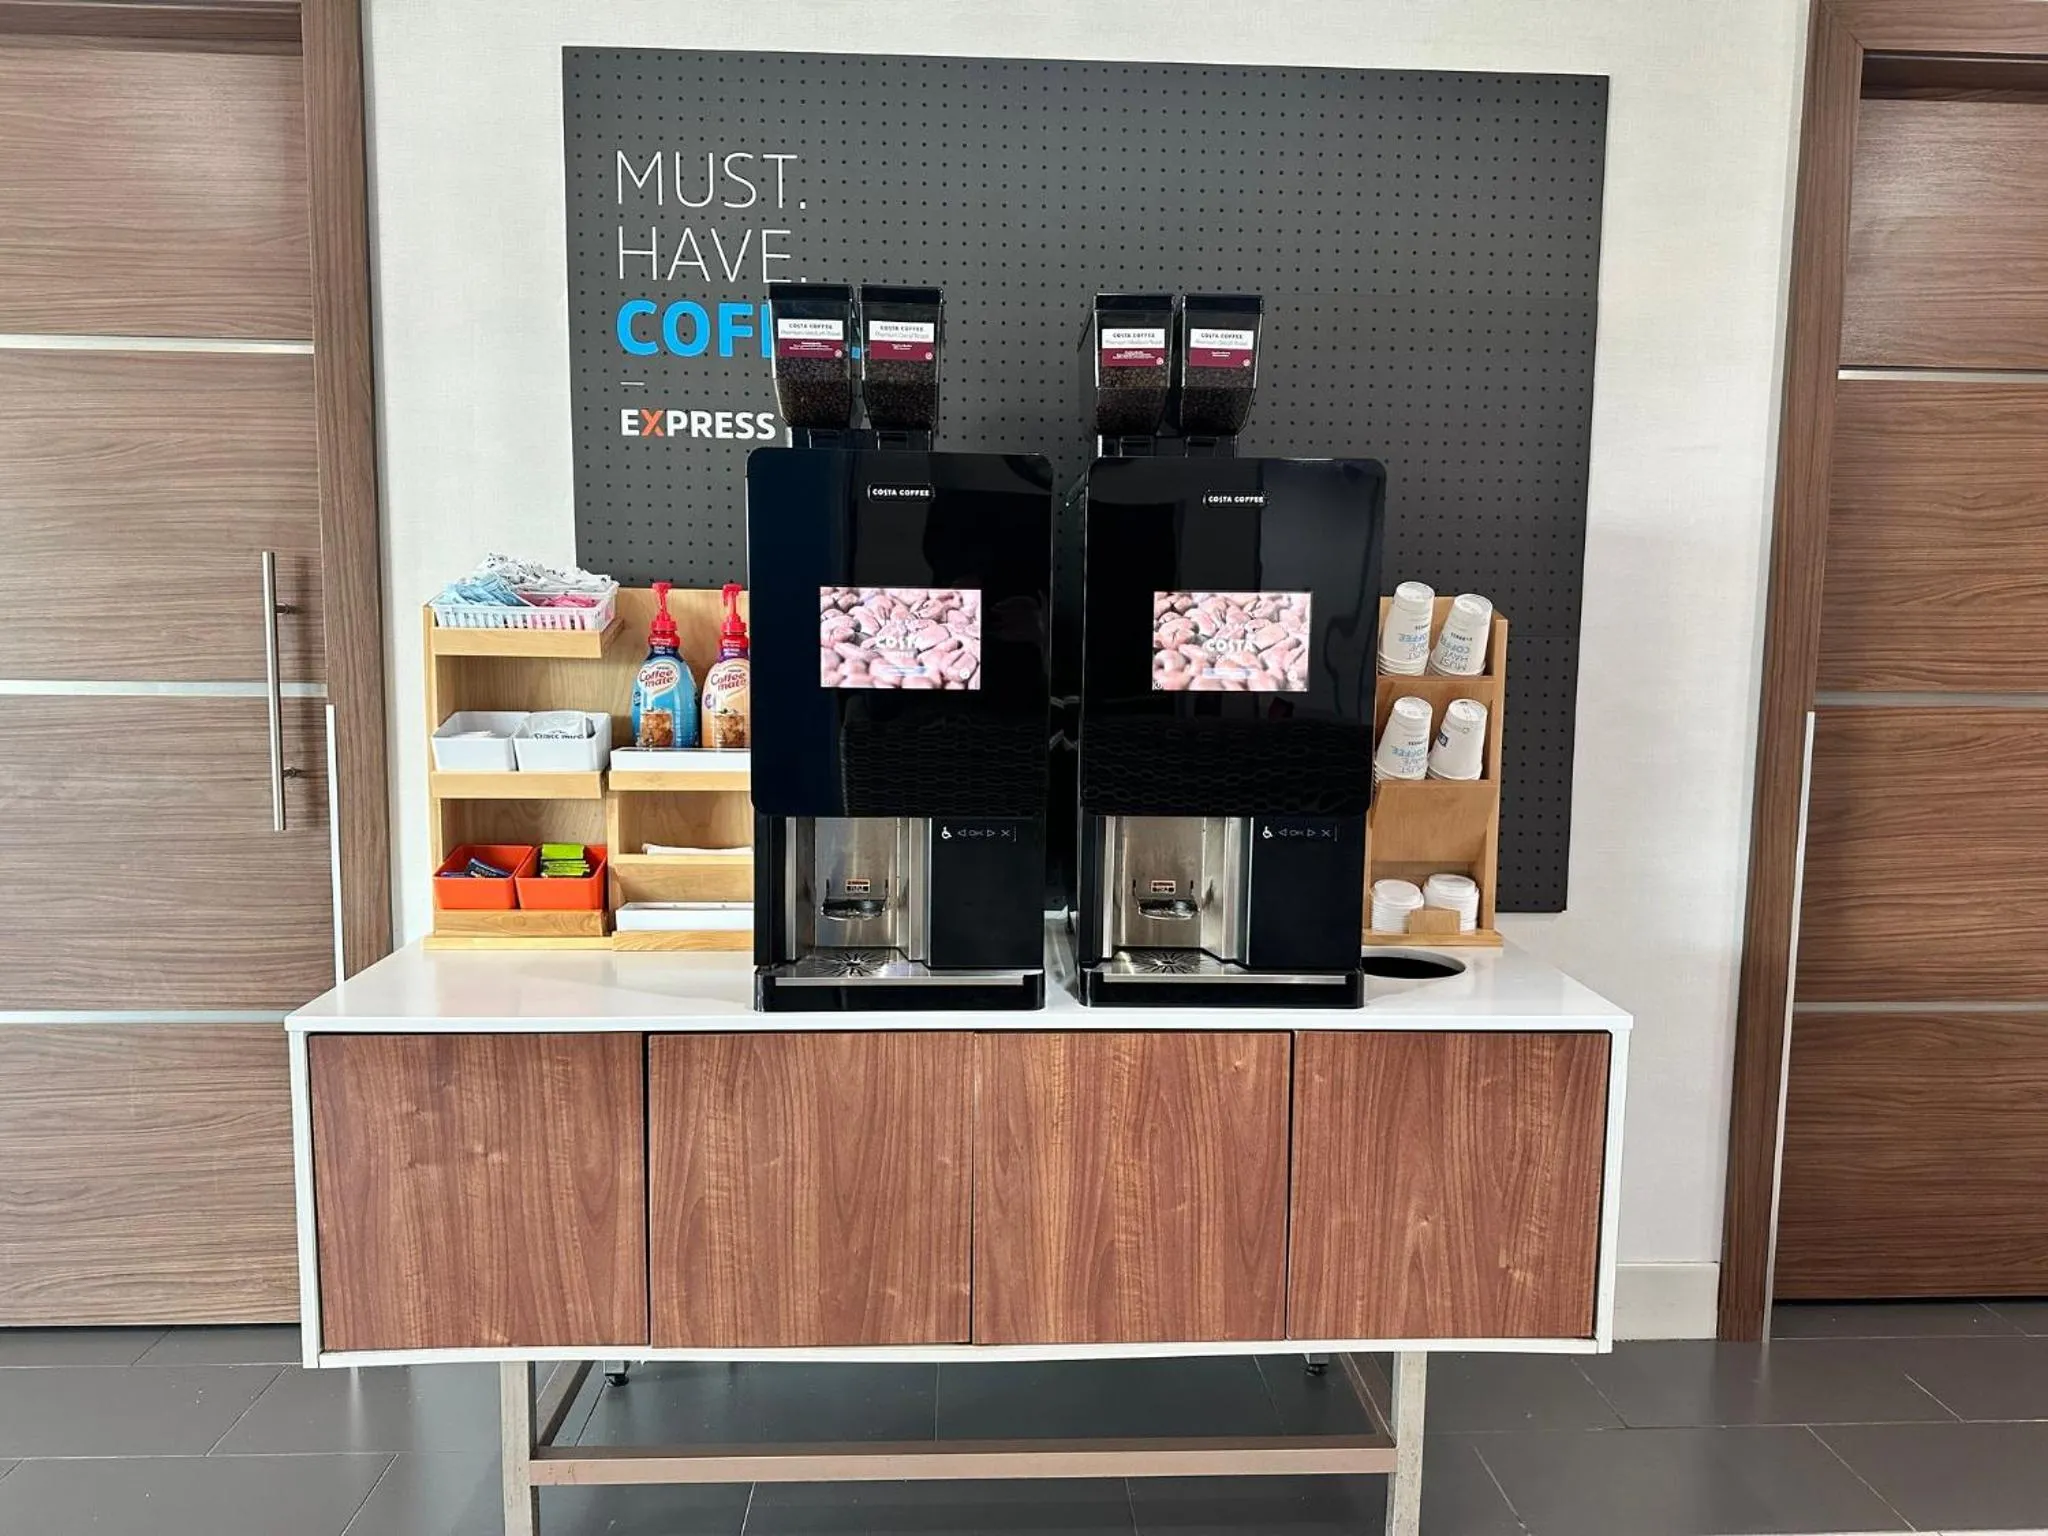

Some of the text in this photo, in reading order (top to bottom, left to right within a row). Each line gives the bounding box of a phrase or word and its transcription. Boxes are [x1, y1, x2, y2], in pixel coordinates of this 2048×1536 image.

[617, 150, 806, 210] MUST.
[617, 225, 806, 283] HAVE.
[620, 408, 776, 441] EXPRESS
[872, 488, 930, 497] COSTA COFFEE
[1208, 495, 1264, 503] COSTA COFFEE
[1207, 637, 1254, 652] COSTA
[640, 669, 673, 682] Coffee
[645, 676, 673, 688] mate
[711, 672, 746, 686] Coffee
[718, 678, 747, 691] mate
